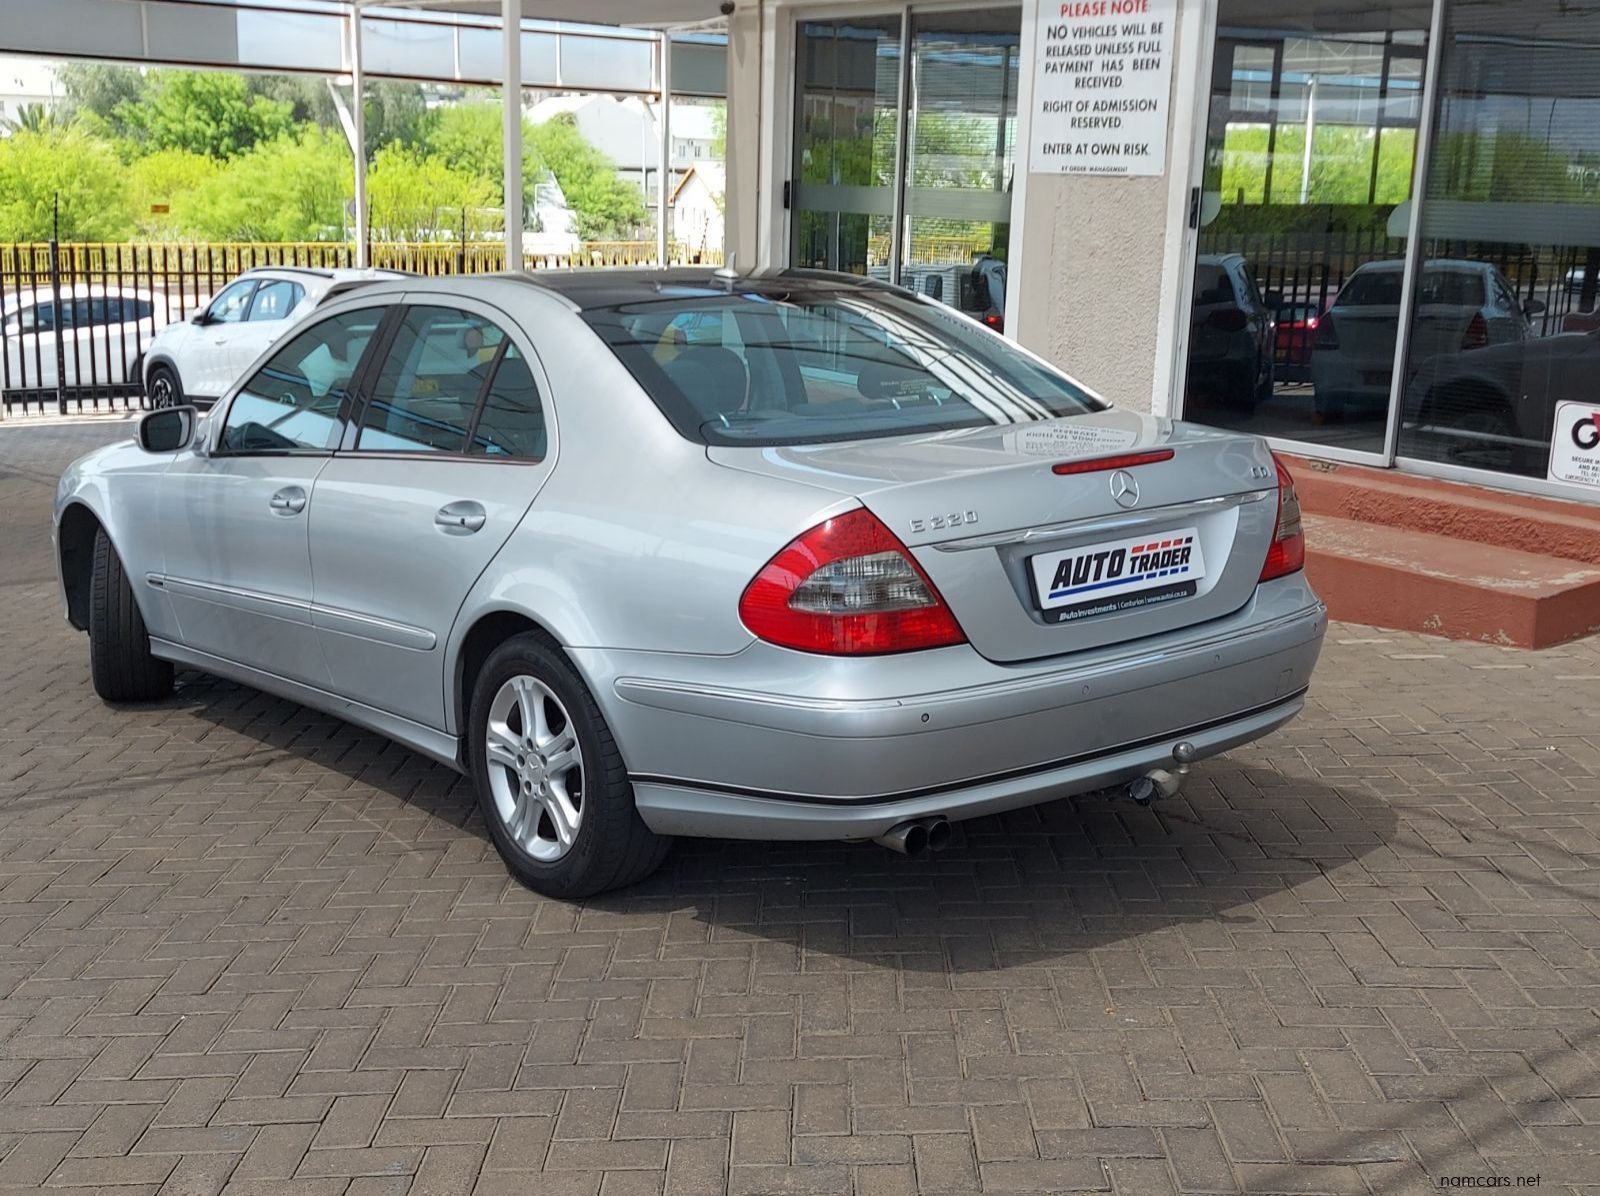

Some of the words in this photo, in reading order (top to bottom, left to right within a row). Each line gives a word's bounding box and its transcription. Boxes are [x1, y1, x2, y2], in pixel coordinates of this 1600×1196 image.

[1061, 1, 1106, 17] PLEASE
[1047, 25, 1068, 40] NO
[1072, 24, 1117, 39] VEHICLES
[1122, 23, 1146, 36] WILL
[1151, 22, 1163, 35] BE
[1046, 44, 1092, 57] RELEASED
[1095, 42, 1134, 56] UNLESS
[1138, 40, 1161, 54] FULL
[1045, 60, 1094, 74] PAYMENT
[1101, 59, 1124, 73] HAS
[1133, 58, 1160, 71] BEEN
[1043, 100, 1073, 112] RIGHT
[1076, 100, 1090, 112] OF
[1093, 99, 1158, 112] ADMISSION
[1043, 143, 1072, 155] ENTER
[1075, 143, 1088, 155] AT
[1091, 143, 1120, 155] OWN
[909, 518, 926, 534] E
[930, 510, 979, 530] 220
[1051, 548, 1127, 590] AUTO
[1130, 546, 1193, 575] TRADER
